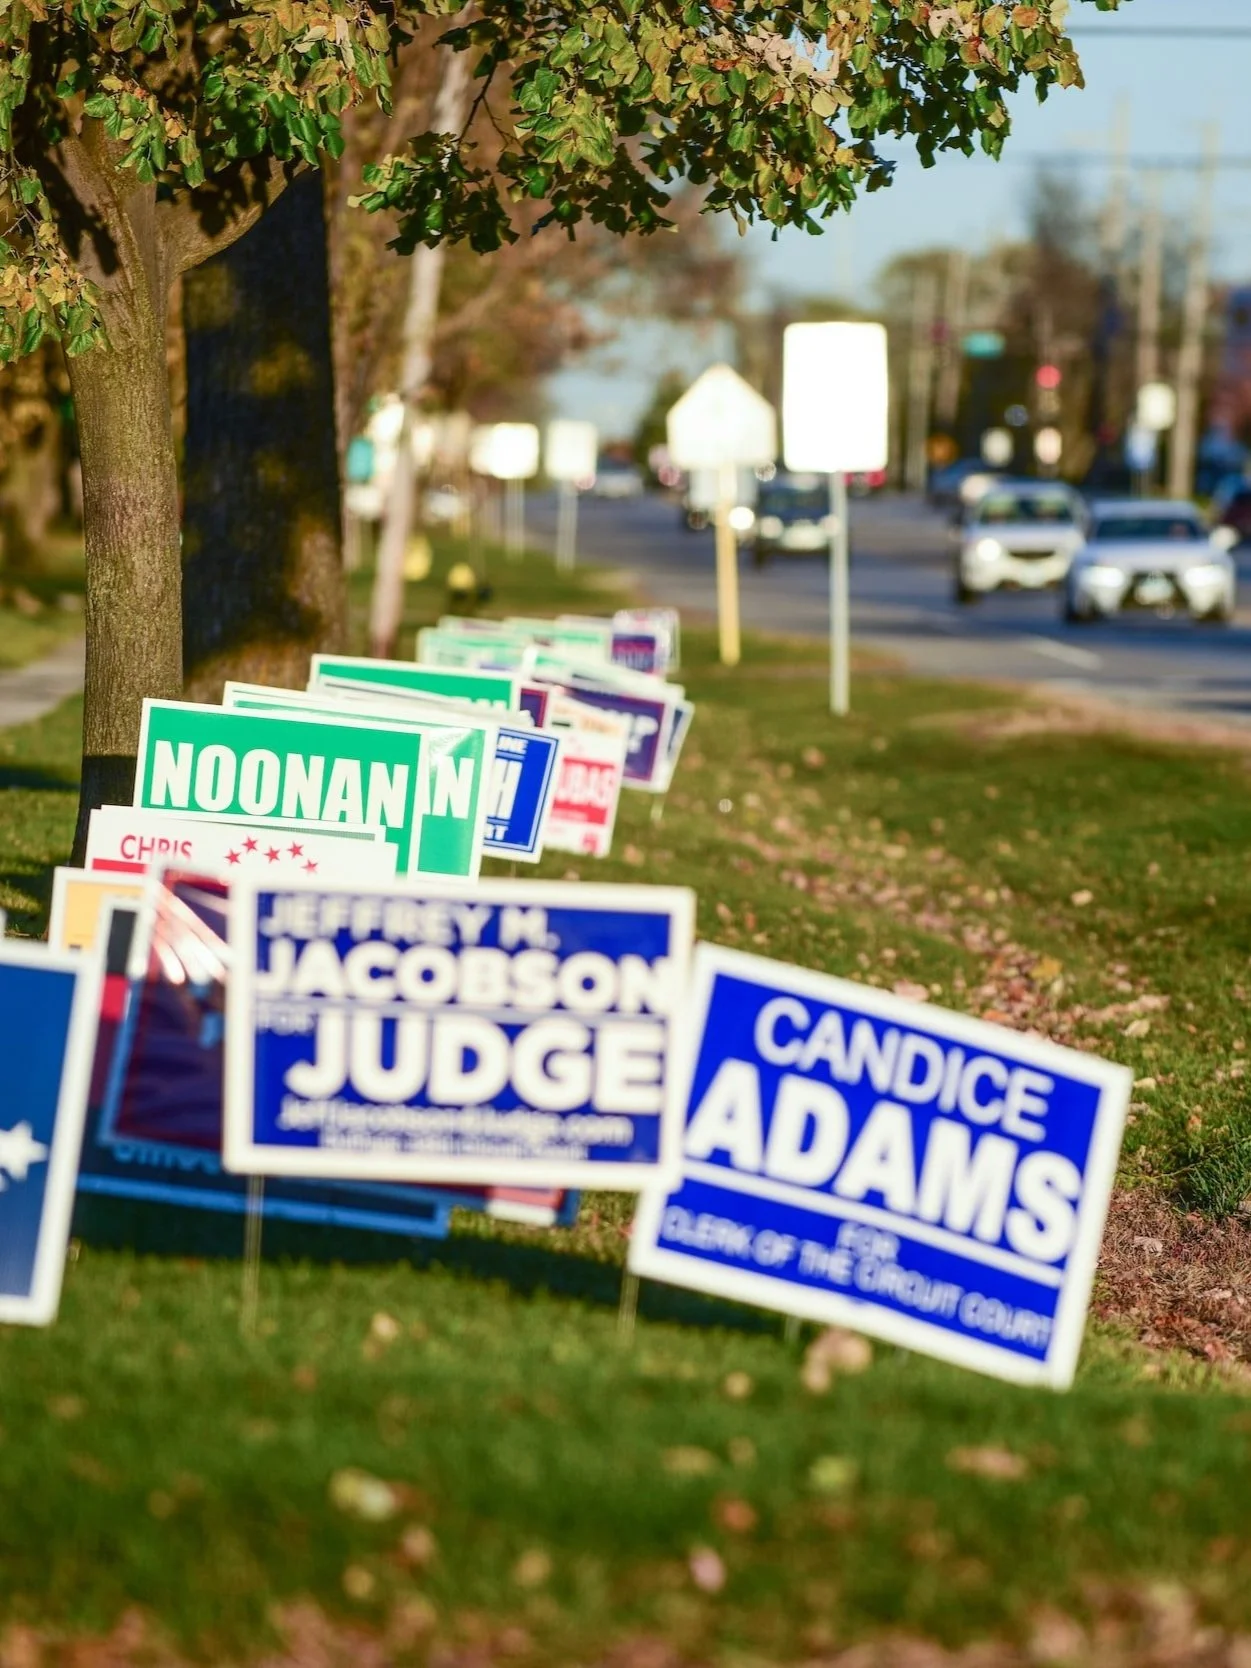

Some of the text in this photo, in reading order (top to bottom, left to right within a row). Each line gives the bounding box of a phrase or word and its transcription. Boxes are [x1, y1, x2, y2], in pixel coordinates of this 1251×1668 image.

[149, 739, 409, 829] NOONAN
[119, 833, 193, 862] CHRIS
[259, 895, 561, 951] JEFFREY M.
[255, 938, 674, 1014] JACOBSON
[284, 1008, 665, 1114] JUDGE
[754, 996, 1056, 1143] CANDICE
[682, 1056, 1083, 1264] ADAMS
[660, 1204, 1054, 1352] CLERK OF THE CIRCUIT COURT
[837, 1221, 900, 1262] FOR
